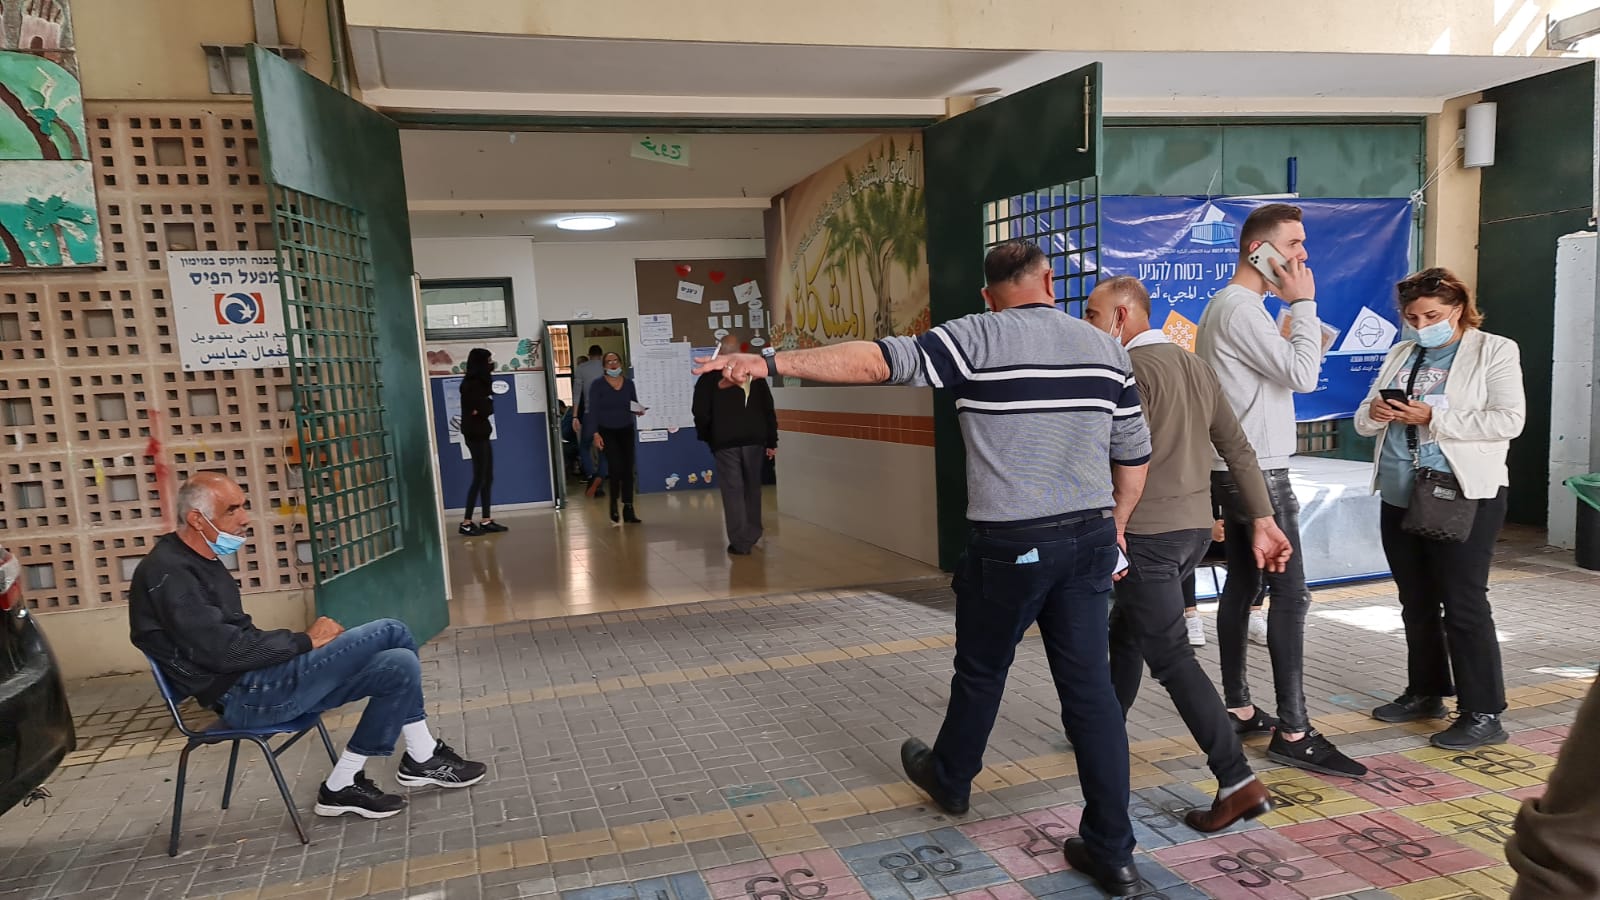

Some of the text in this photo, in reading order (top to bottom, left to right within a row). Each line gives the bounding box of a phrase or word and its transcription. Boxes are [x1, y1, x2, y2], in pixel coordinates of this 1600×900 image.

[180, 256, 285, 268] מבנה הוקם במימון
[1138, 260, 1172, 281] להגיע
[1174, 262, 1203, 281] בטוח
[188, 268, 281, 285] מפעל הפיס
[1162, 285, 1197, 306] المجيء
[190, 332, 233, 344] بتمويل
[237, 330, 269, 344] المبنى
[1400, 371, 1441, 385] GESS
[1453, 750, 1536, 776] 93
[1337, 827, 1432, 865] 85
[879, 844, 963, 883] 98
[1210, 849, 1304, 888] 86
